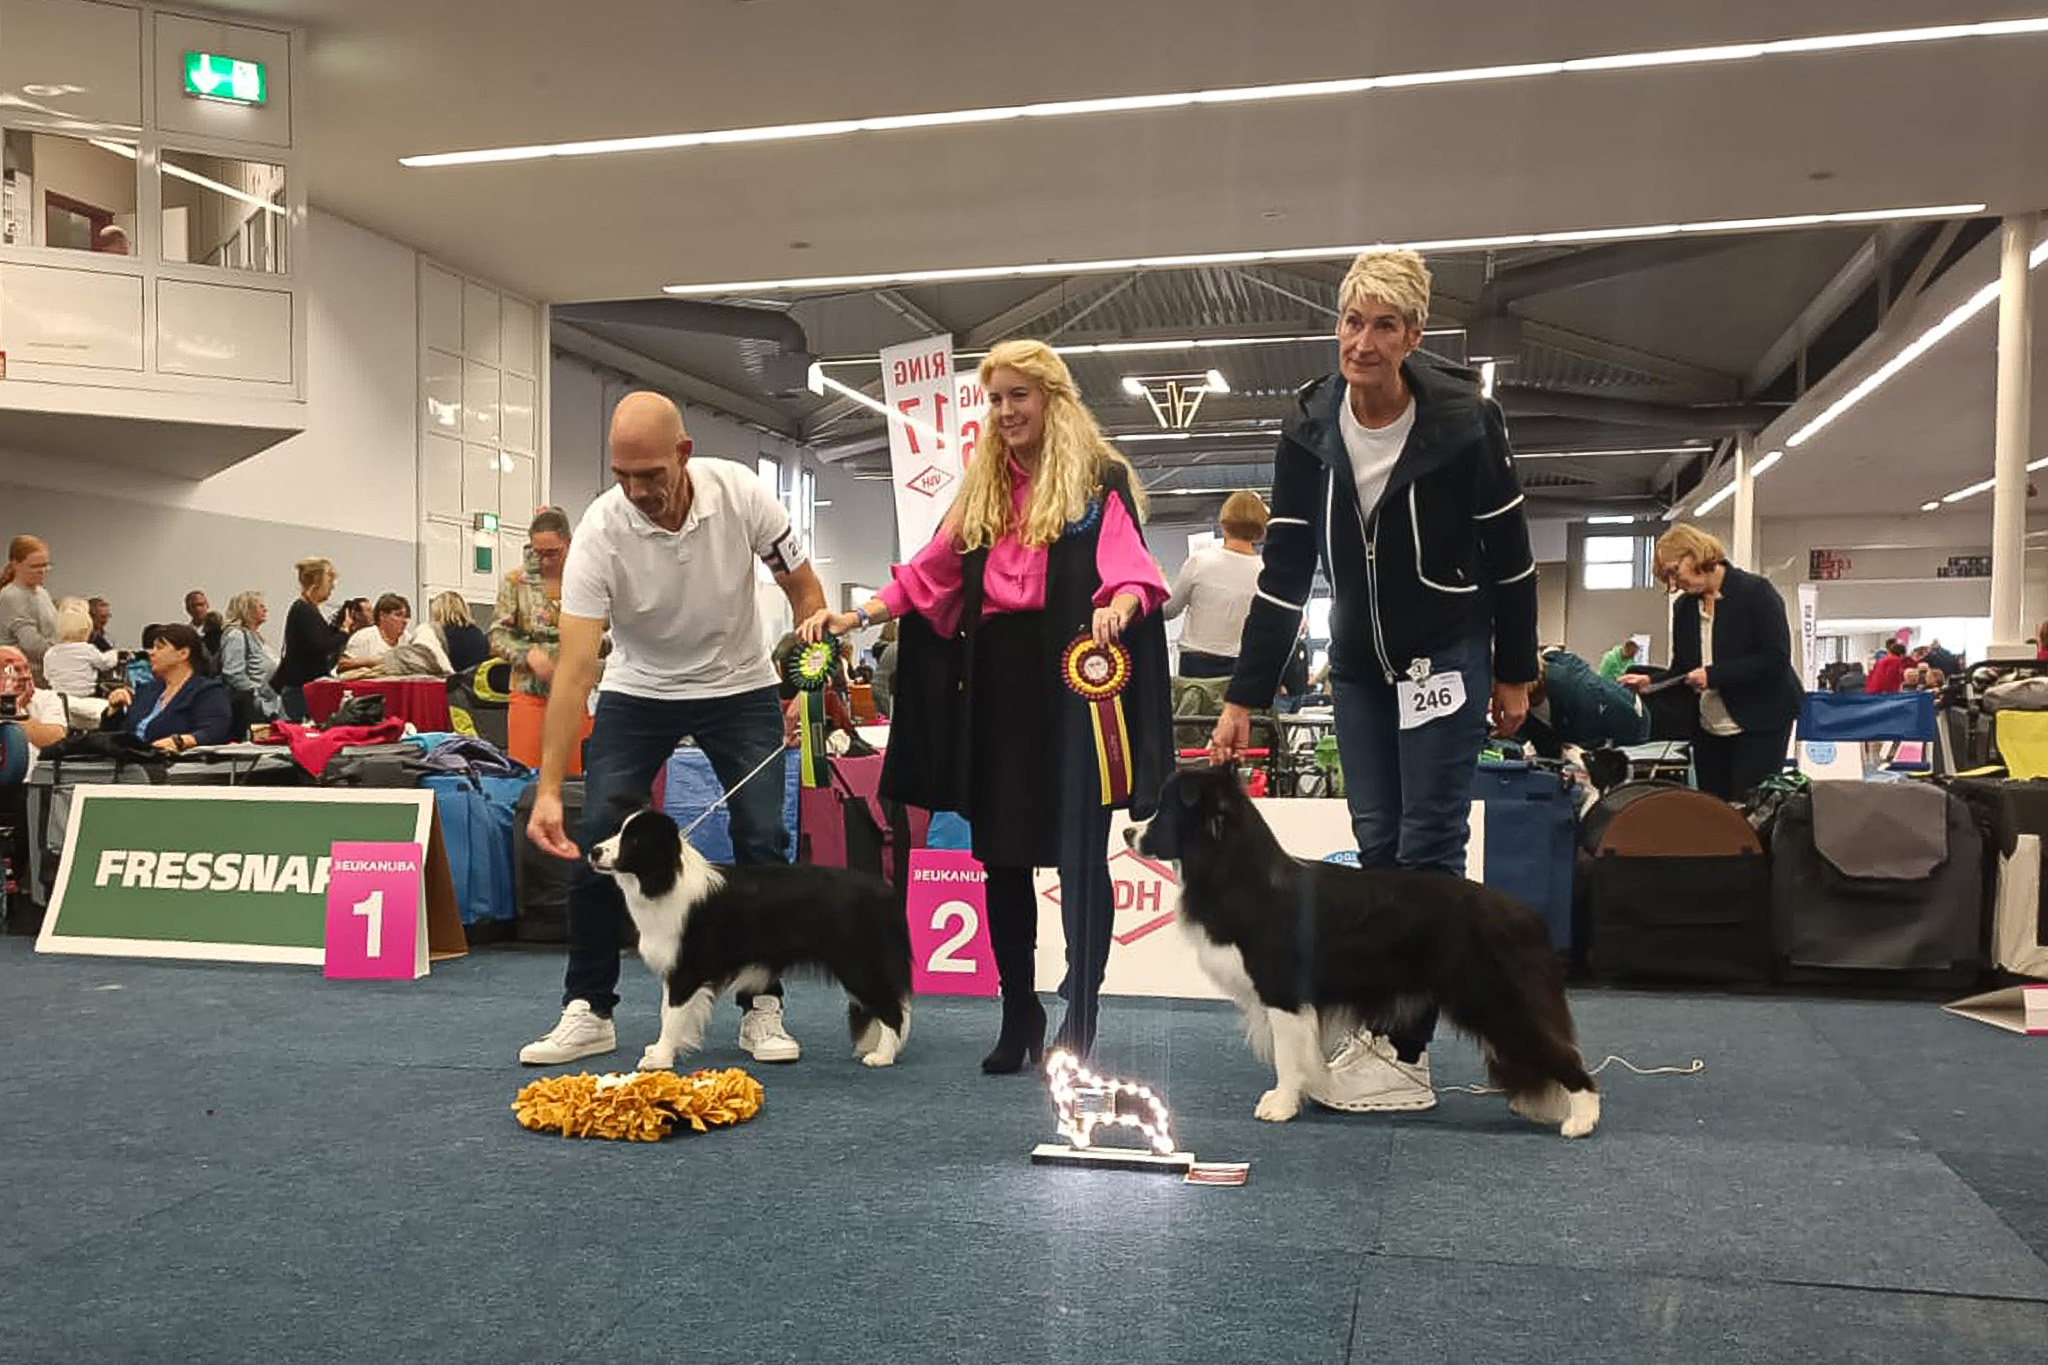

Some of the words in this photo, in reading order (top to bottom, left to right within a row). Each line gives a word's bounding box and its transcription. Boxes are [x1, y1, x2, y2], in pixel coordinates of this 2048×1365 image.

[1414, 688, 1452, 712] 246
[94, 850, 332, 894] FRESSNAP
[1114, 880, 1161, 912] DH
[353, 890, 383, 957] 1
[927, 900, 978, 973] 2
